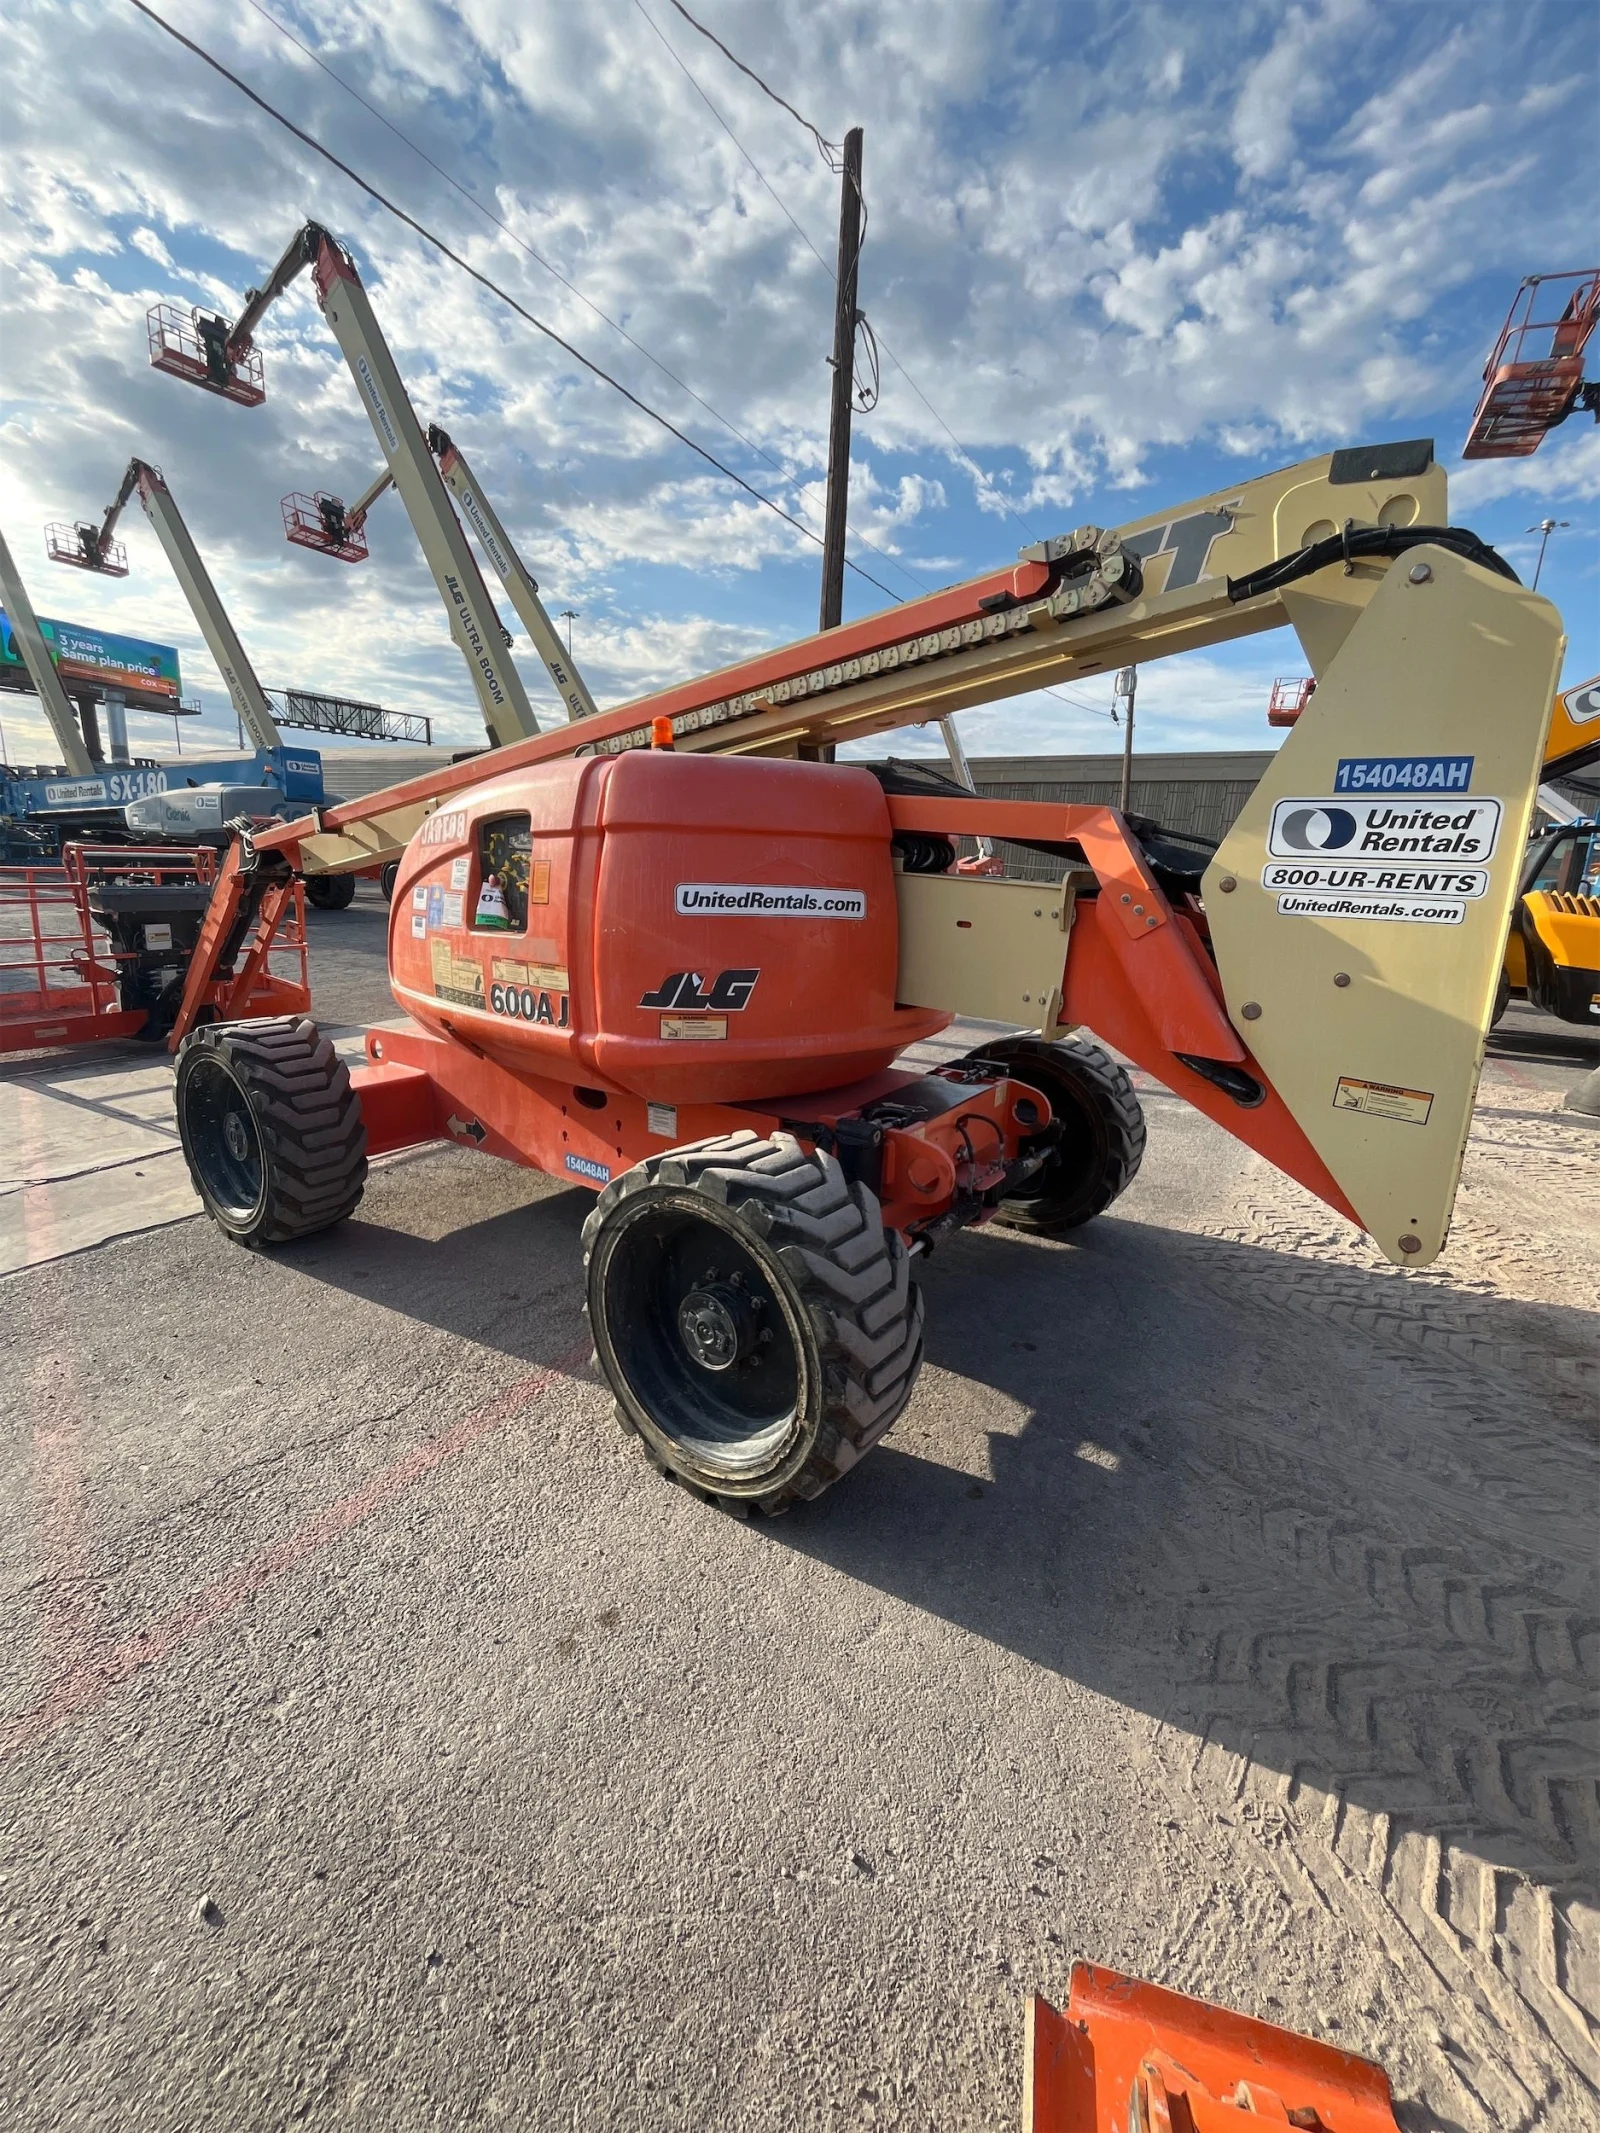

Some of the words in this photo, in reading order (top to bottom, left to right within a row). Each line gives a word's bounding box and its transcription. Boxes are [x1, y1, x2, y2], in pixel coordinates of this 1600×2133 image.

[364, 374, 381, 408] United
[379, 408, 396, 448] Rentals
[471, 506, 490, 538] United
[487, 538, 508, 573] Rentals
[60, 634, 68, 646] 3
[70, 639, 104, 654] years
[444, 575, 465, 605] JLG
[460, 607, 484, 656] ULTRA
[479, 657, 504, 705] BOOM
[61, 647, 96, 663] Same
[99, 656, 125, 669] plan
[127, 662, 156, 676] price
[550, 662, 568, 684] JLG
[235, 687, 251, 717] ULTRA
[249, 717, 265, 747] BOOM
[110, 771, 167, 801] SX-180
[1338, 763, 1468, 788] 154048AH
[56, 786, 78, 799] United
[78, 783, 103, 797] Rentals
[1366, 809, 1477, 830] United
[1360, 832, 1481, 854] Rentals
[1271, 869, 1477, 892] 800-UR-RENTS
[682, 891, 861, 913] UnitedRentals.com
[1282, 898, 1459, 919] UnitedRentals.com
[638, 968, 760, 1010] JLG
[490, 983, 569, 1028] 600AJ
[1369, 1084, 1404, 1095] WARNING
[565, 1155, 610, 1182] 154048AH
